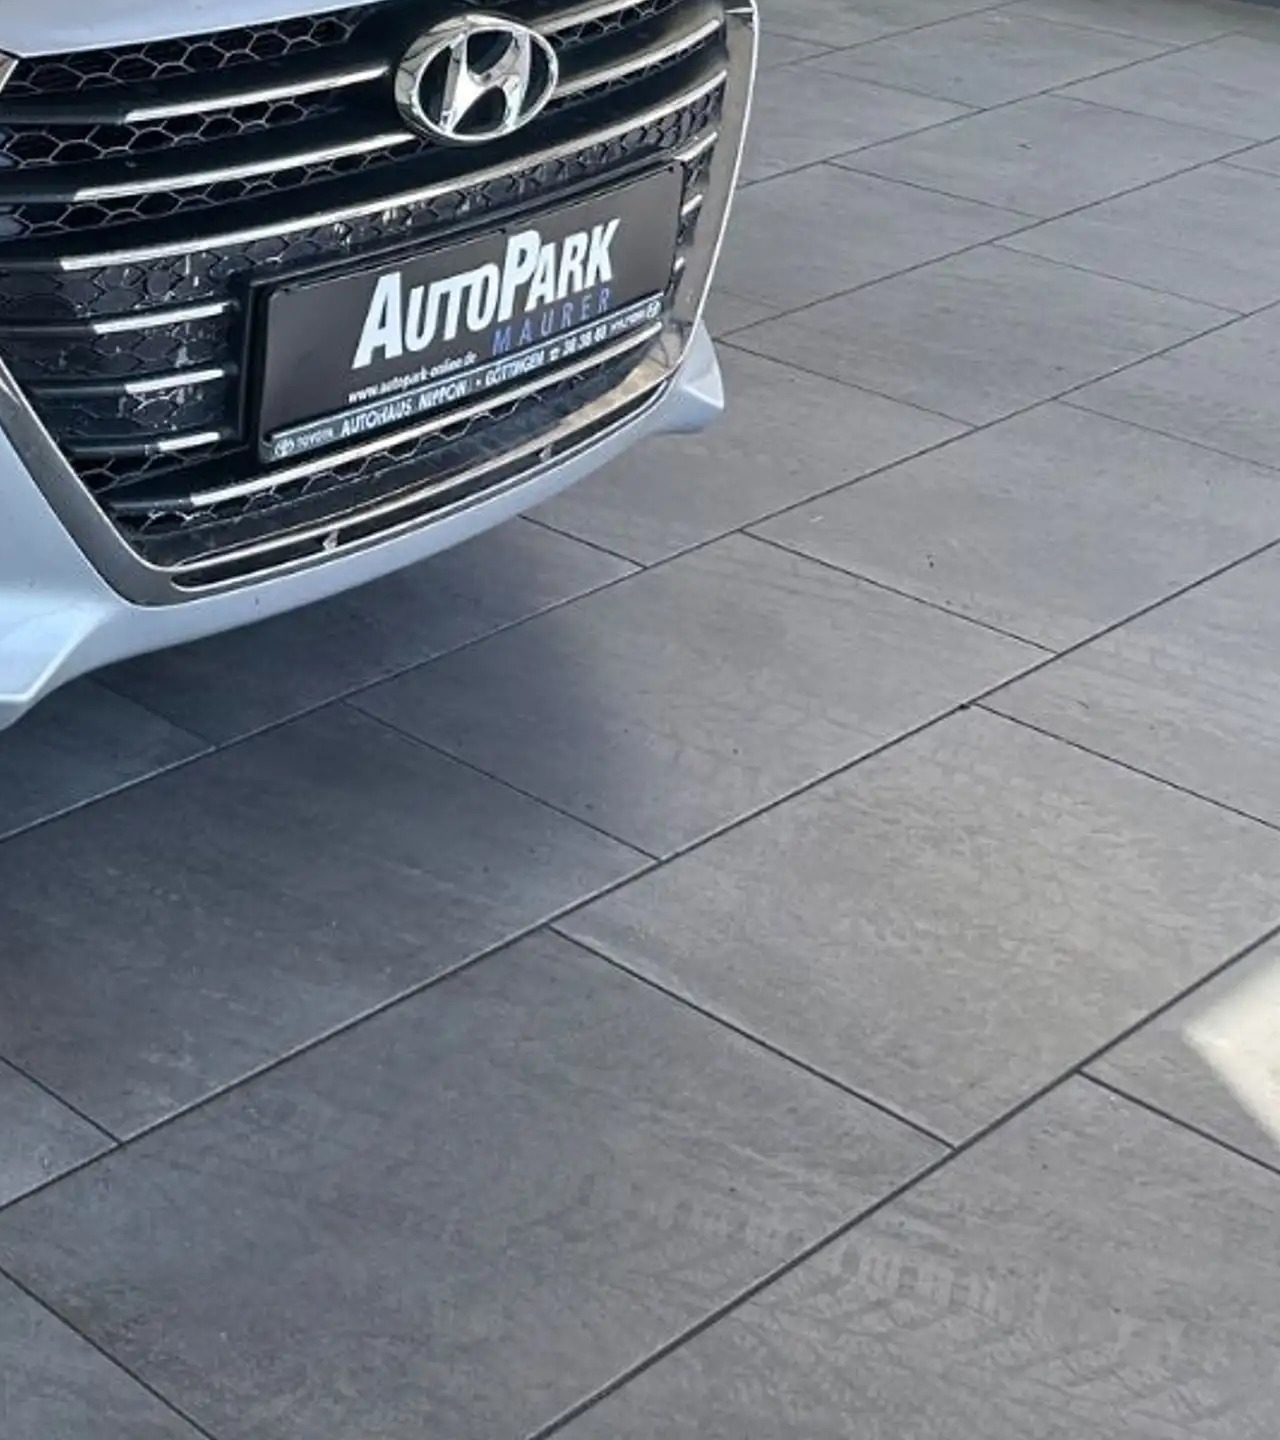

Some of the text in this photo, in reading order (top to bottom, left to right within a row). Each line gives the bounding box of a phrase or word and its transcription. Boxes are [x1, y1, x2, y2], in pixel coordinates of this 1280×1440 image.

[491, 287, 612, 357] MAURER
[340, 397, 413, 438] AUTOHAUS
[418, 377, 469, 412] NIPPON
